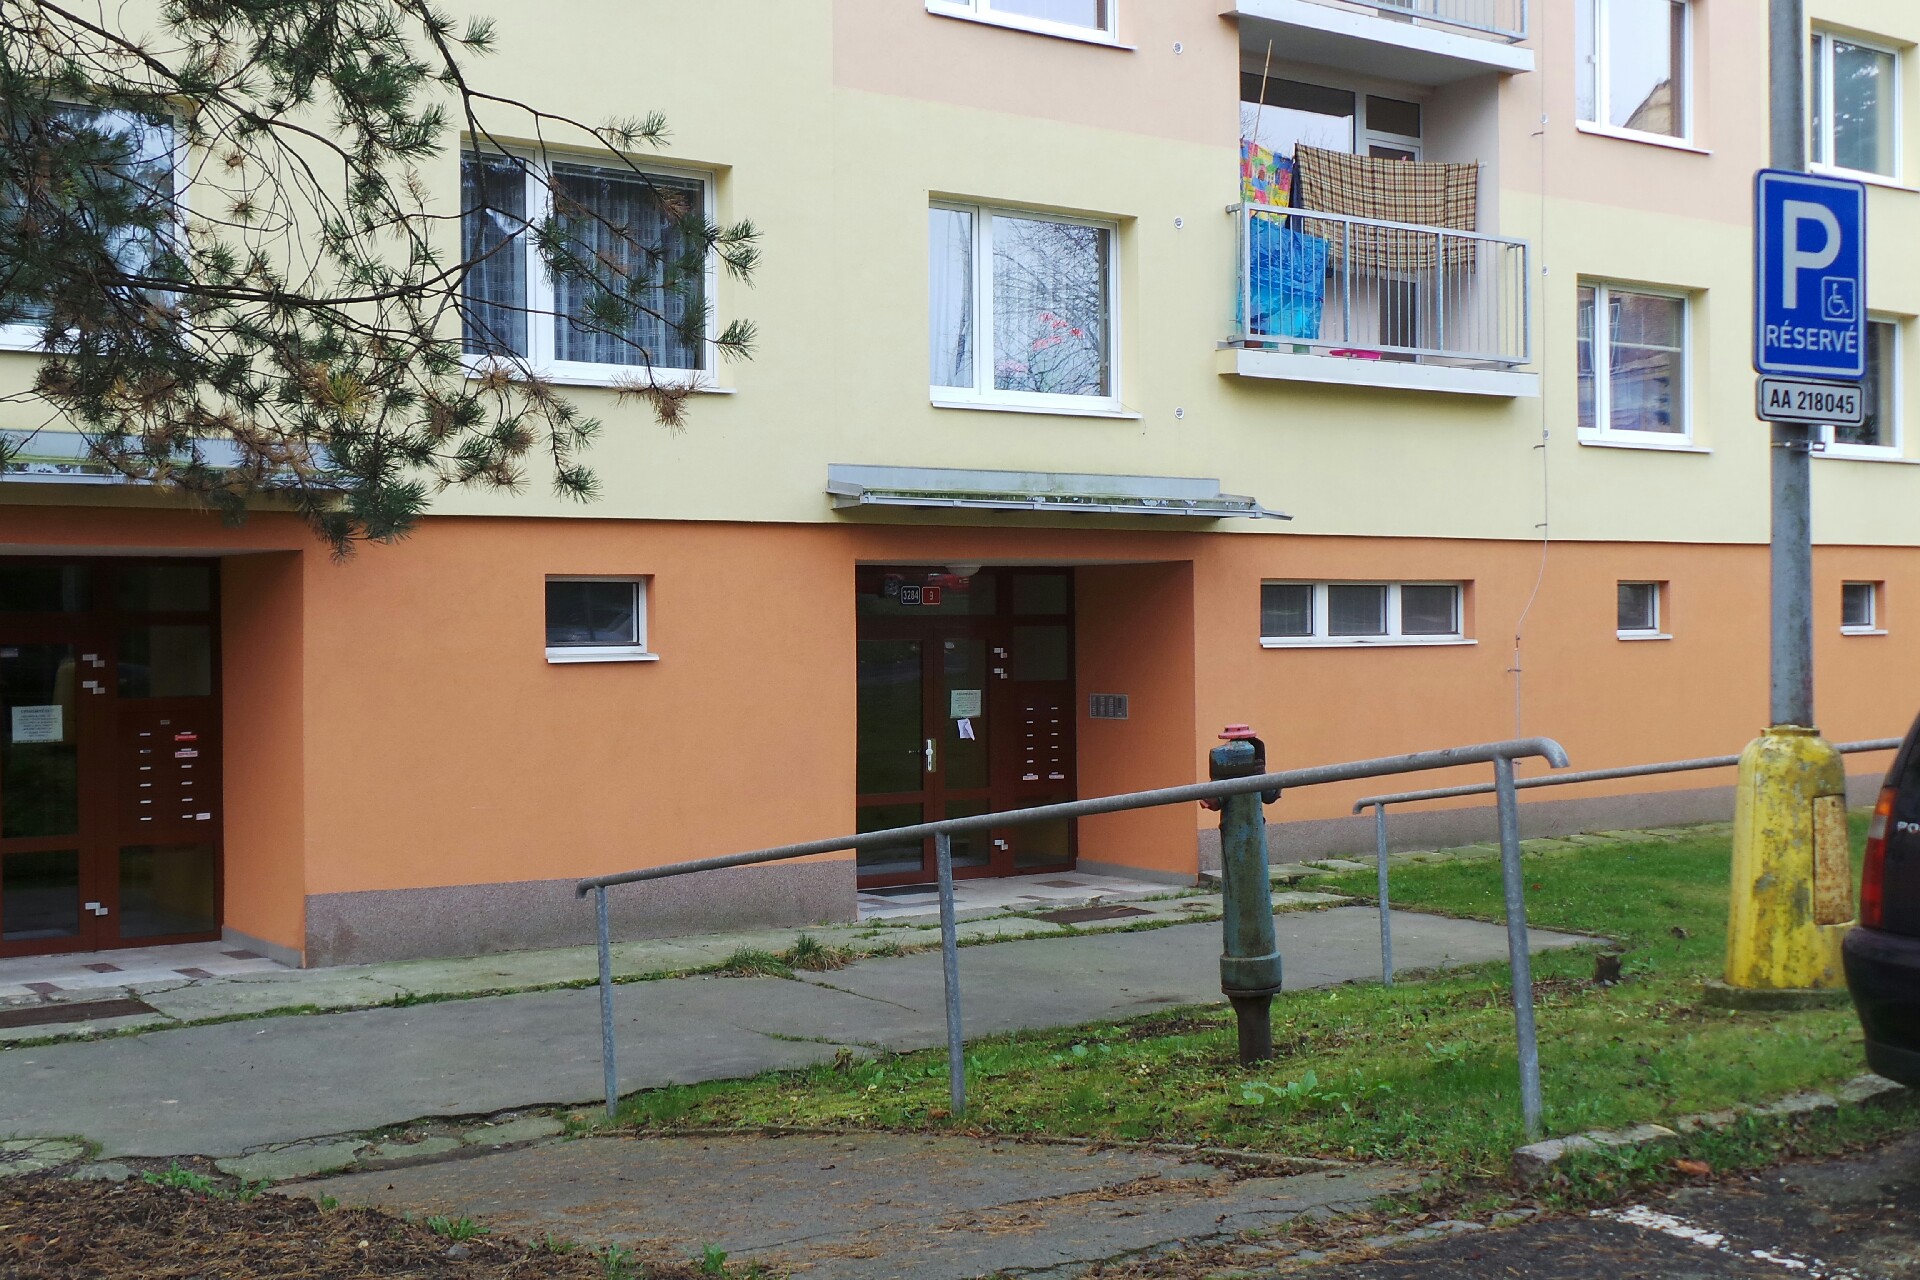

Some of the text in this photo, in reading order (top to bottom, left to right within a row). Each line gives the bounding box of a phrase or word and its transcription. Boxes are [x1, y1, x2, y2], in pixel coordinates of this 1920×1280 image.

[1782, 199, 1841, 309] P
[1765, 320, 1858, 353] RÉSERVÉ
[1770, 388, 1854, 414] AA 218045
[1897, 820, 1920, 833] PO
